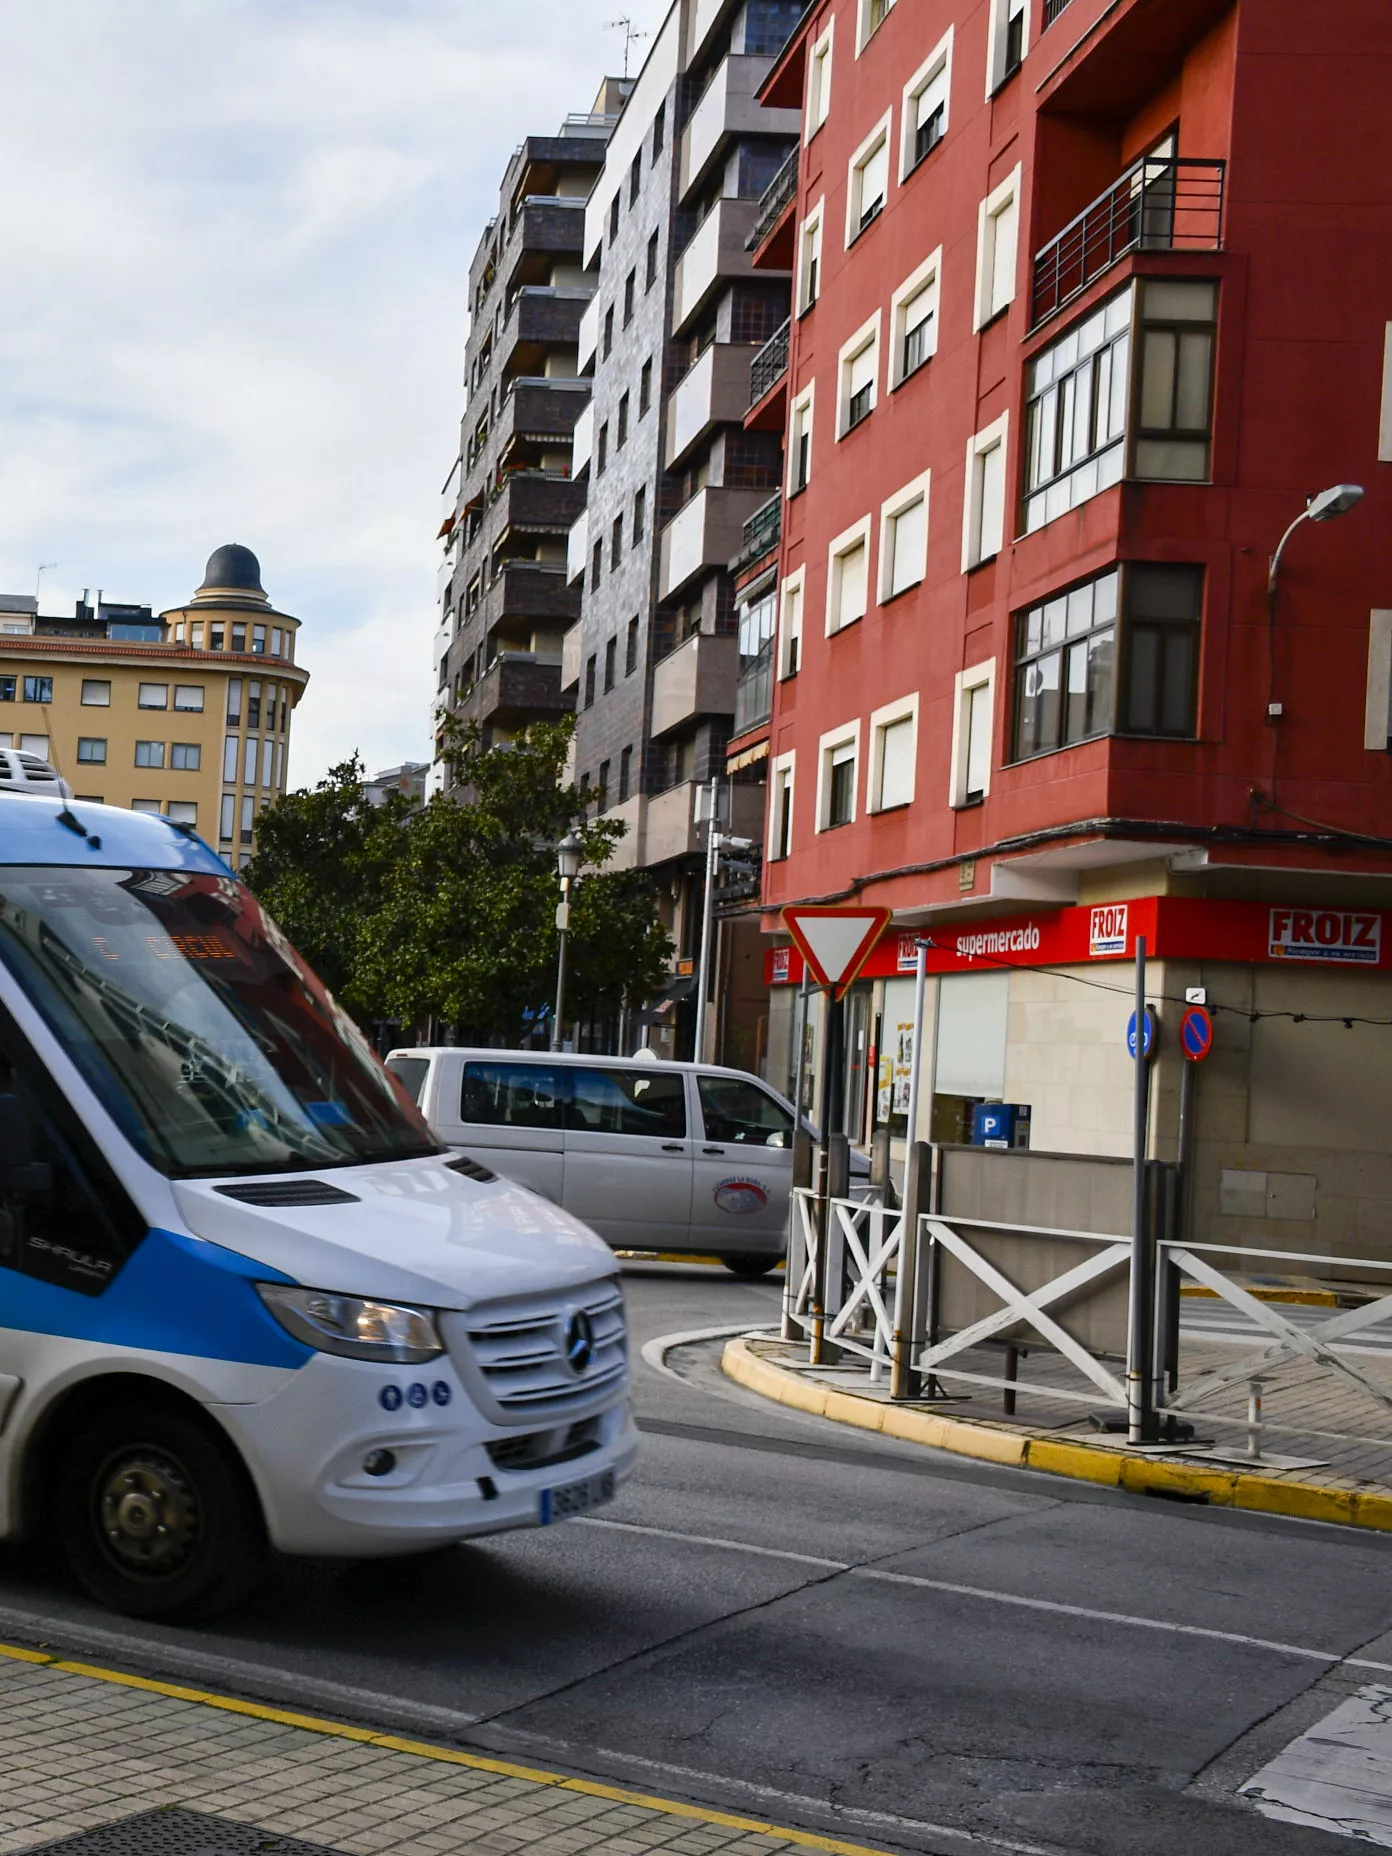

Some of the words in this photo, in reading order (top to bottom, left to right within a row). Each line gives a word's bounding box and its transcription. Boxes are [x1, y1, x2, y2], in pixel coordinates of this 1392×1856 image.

[1092, 908, 1125, 939] FROIZ
[1273, 910, 1379, 948] FROIZ
[956, 921, 1040, 961] supermercado
[984, 1117, 996, 1133] P
